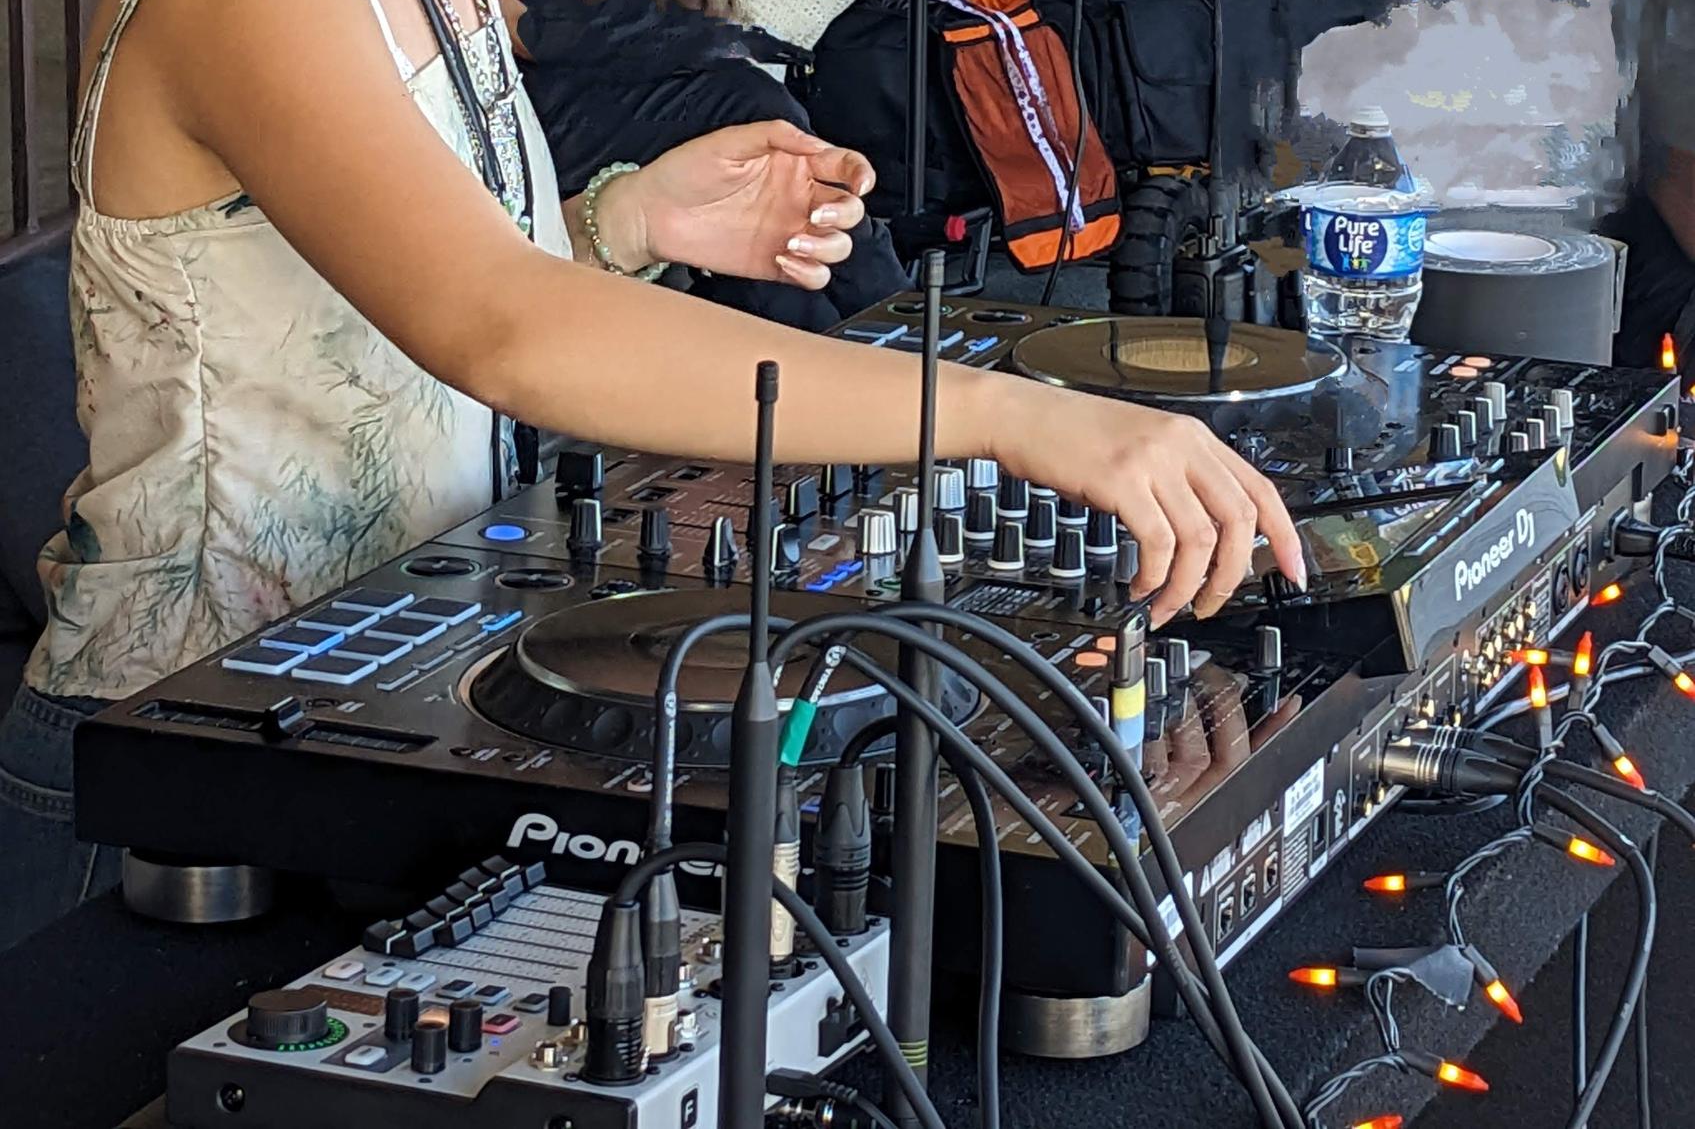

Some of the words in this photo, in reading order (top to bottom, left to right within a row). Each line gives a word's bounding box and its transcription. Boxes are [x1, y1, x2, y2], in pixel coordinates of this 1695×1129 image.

[1334, 215, 1380, 237] Pure
[1338, 232, 1374, 259] Life
[1455, 529, 1515, 602] Pioneer
[1516, 508, 1535, 548] DJ
[506, 812, 724, 878] Pion
